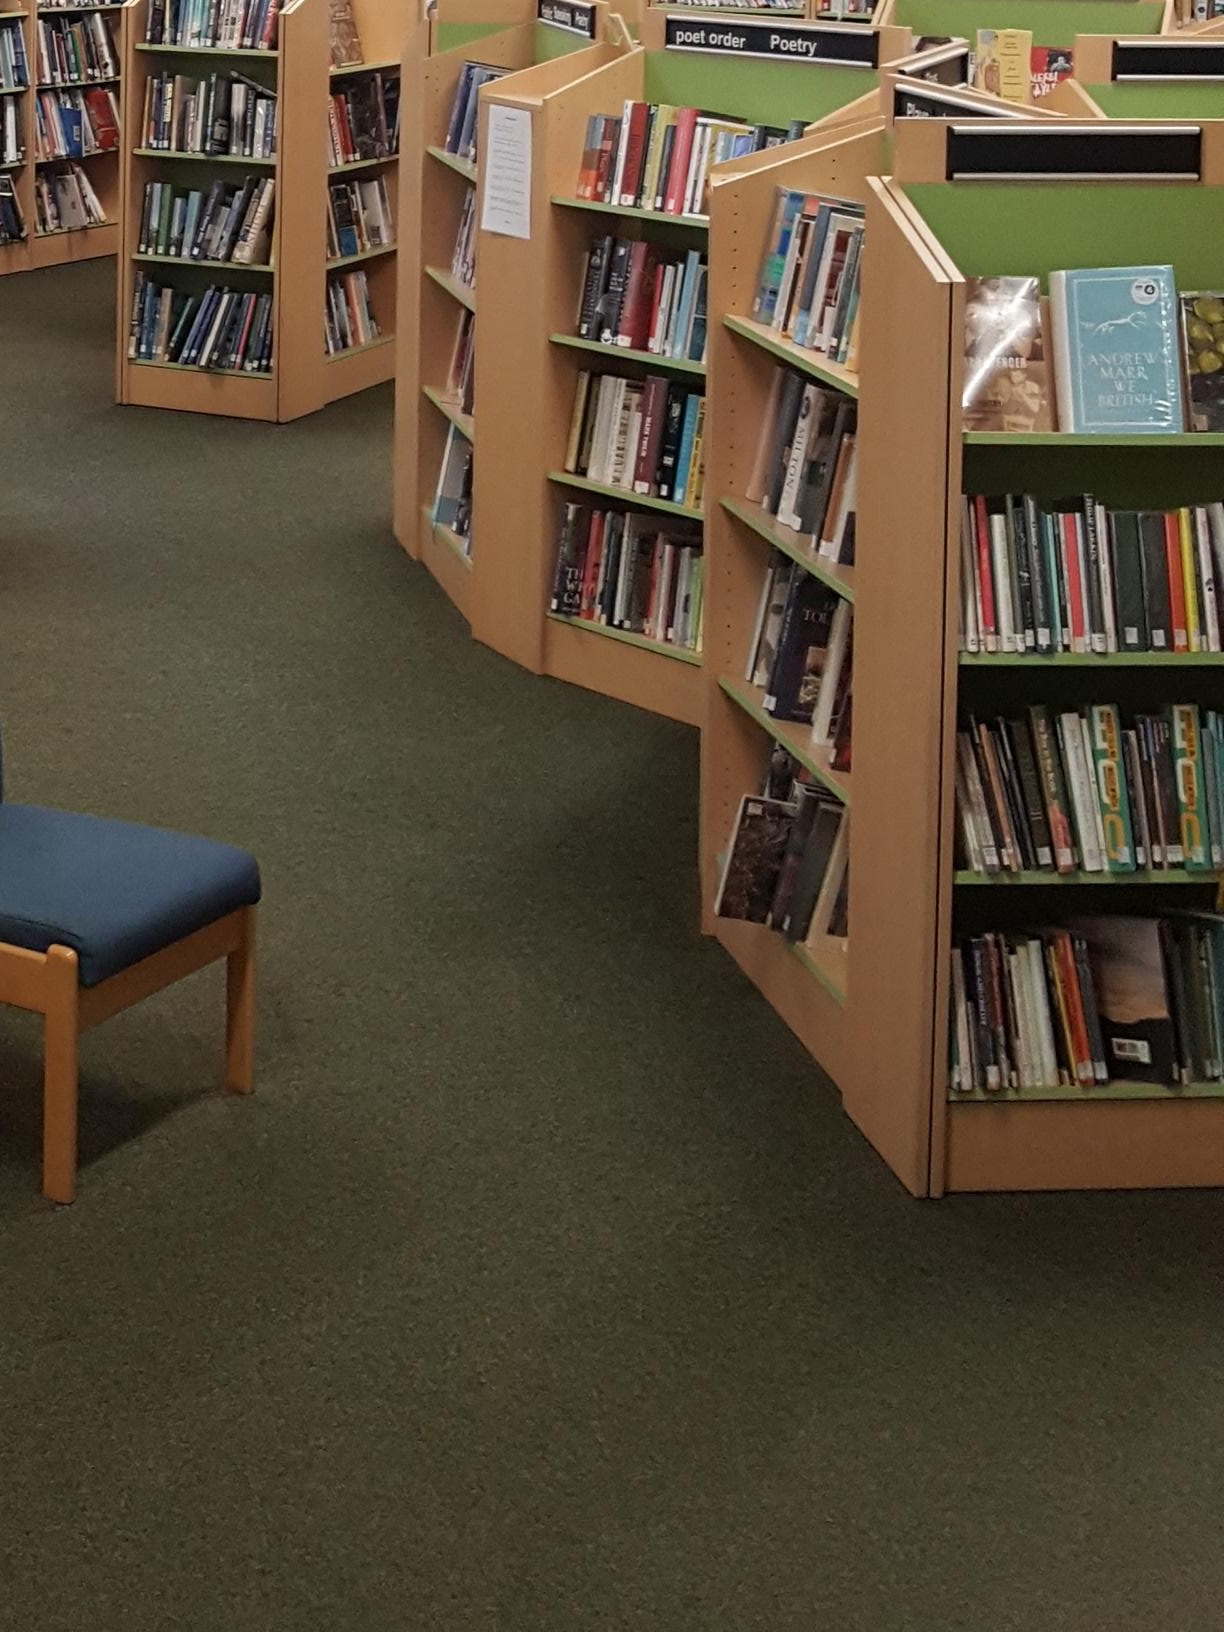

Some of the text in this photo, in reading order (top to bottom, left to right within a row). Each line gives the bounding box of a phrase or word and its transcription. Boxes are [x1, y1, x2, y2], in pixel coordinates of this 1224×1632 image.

[676, 30, 817, 56] poet order Poetry
[1089, 352, 1157, 366] ANDREW
[1100, 366, 1149, 380] MARR
[1114, 380, 1136, 393] WE
[1097, 393, 1153, 408] BRITISH
[786, 426, 804, 491] MILTON
